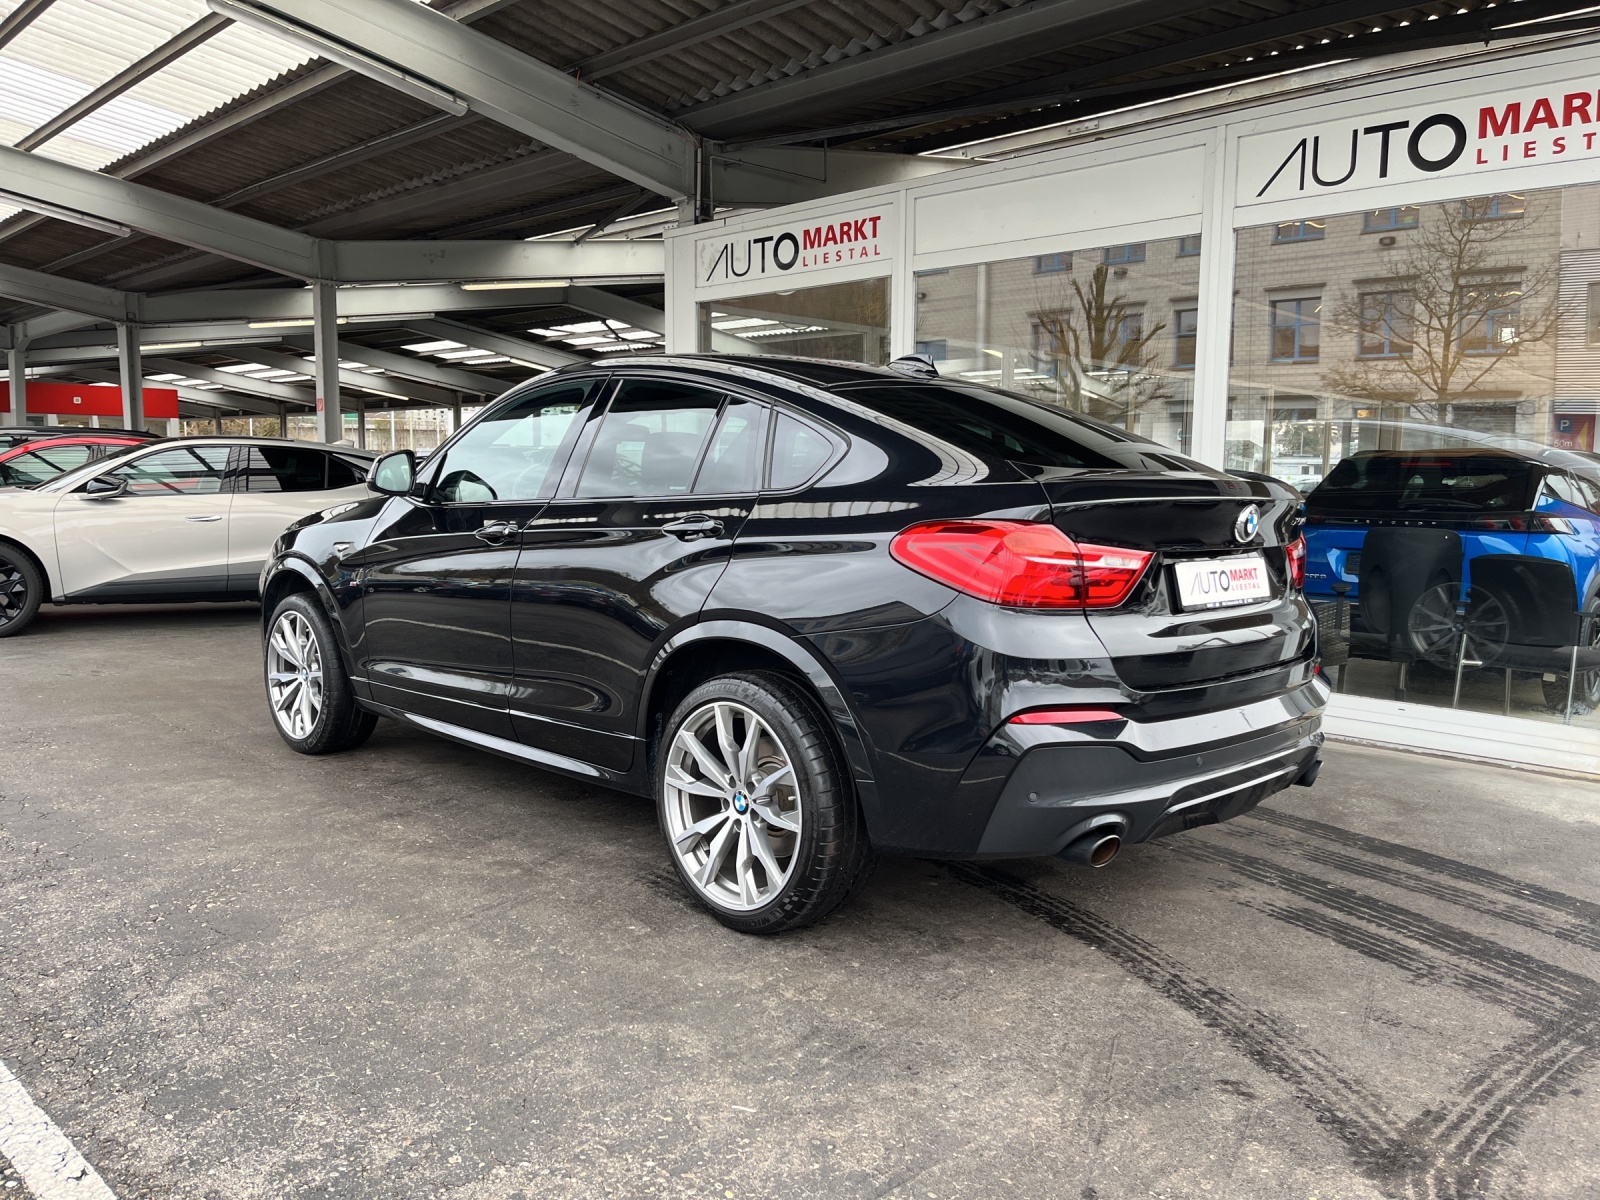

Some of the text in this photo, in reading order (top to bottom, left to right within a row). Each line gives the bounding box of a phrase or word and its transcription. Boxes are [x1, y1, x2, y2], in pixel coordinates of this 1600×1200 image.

[1255, 89, 1600, 198] AUTO MAR
[706, 216, 881, 282] AUTO MARKT
[802, 244, 881, 267] LIESTAL
[1560, 420, 1570, 431] P
[1553, 439, 1573, 448] 50m
[1190, 567, 1258, 596] AUTO MARKT
[1232, 582, 1261, 591] LIESTAL
